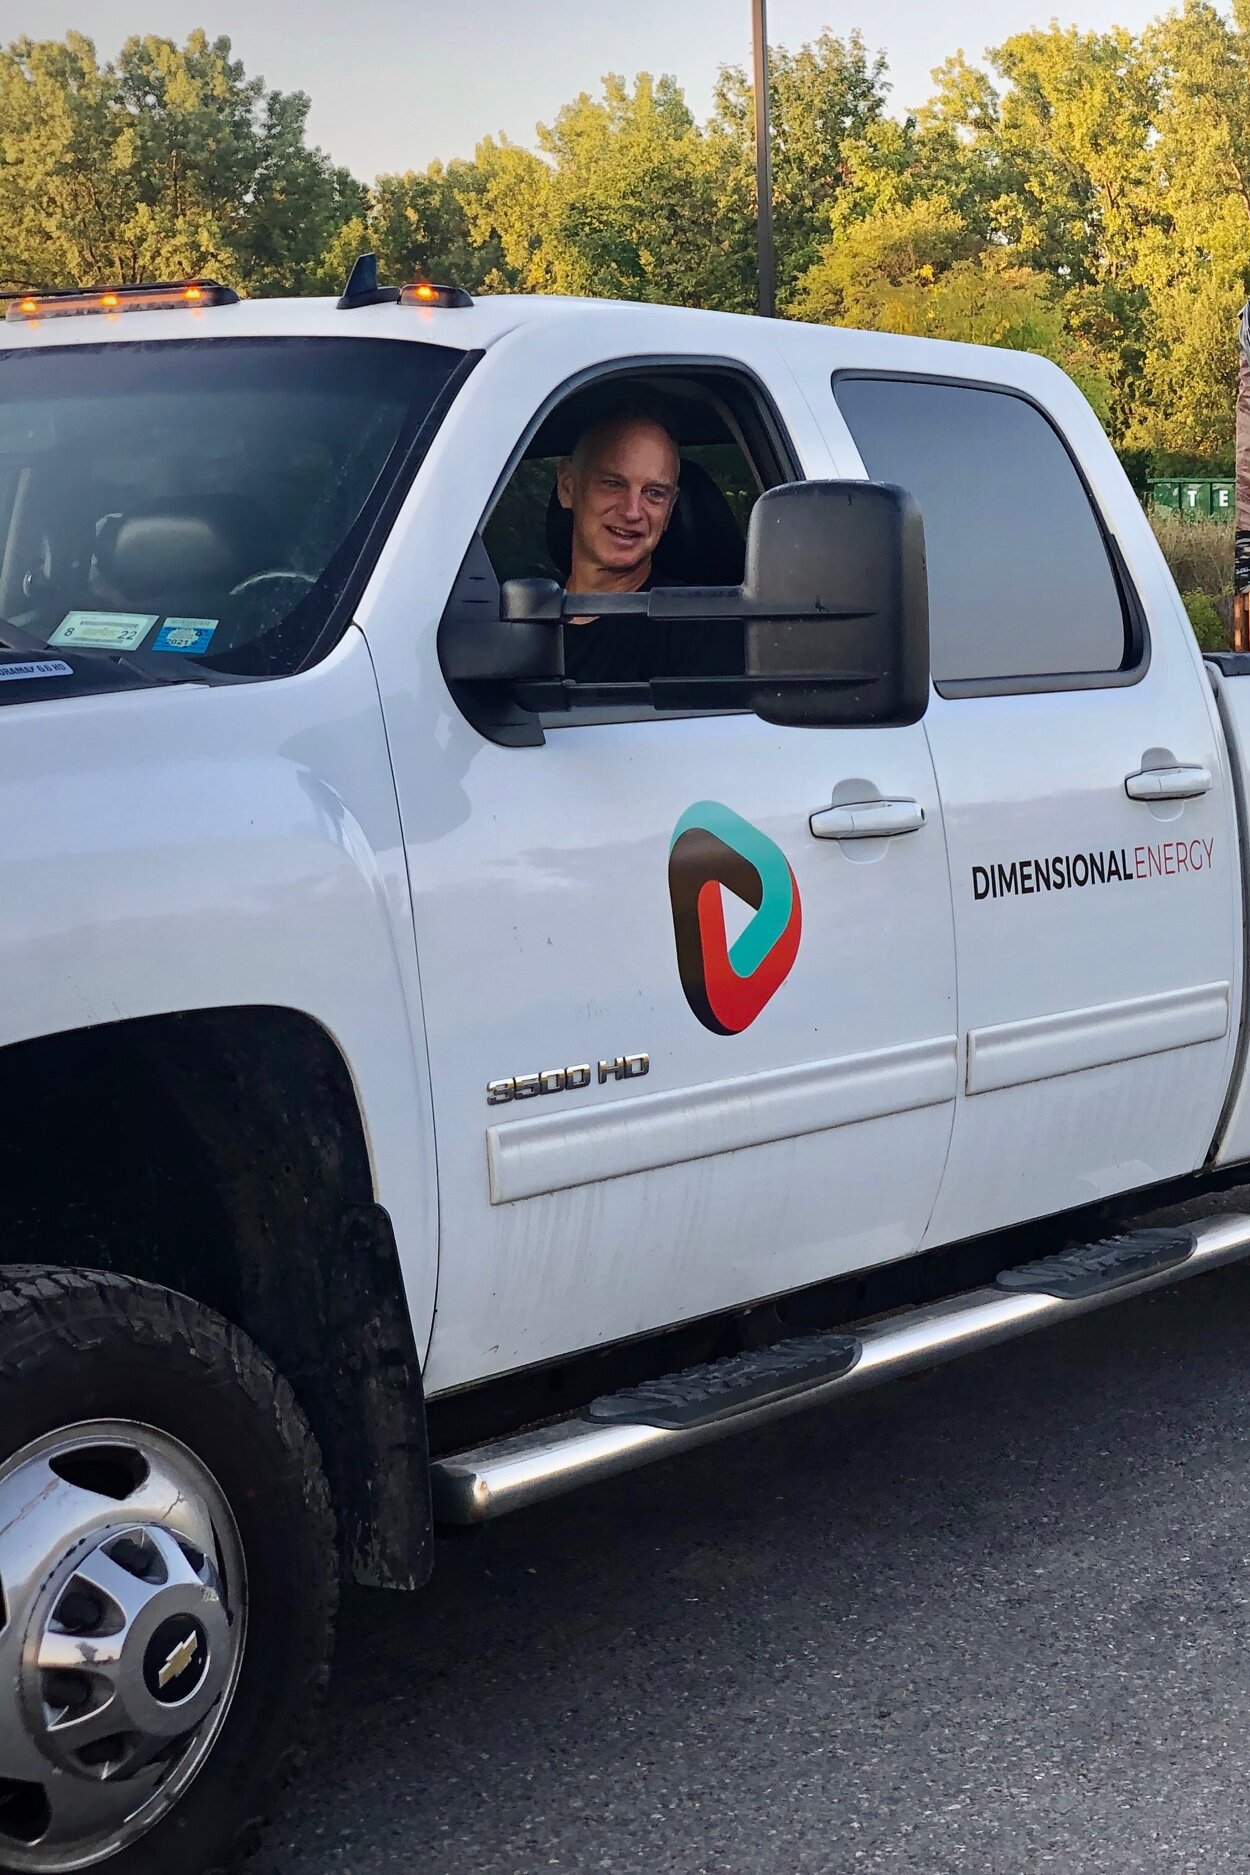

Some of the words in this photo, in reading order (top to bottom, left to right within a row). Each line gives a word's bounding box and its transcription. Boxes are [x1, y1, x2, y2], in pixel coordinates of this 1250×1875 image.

[64, 627, 75, 637] 8
[118, 630, 137, 640] 22
[972, 848, 1133, 901] DIMENSIONAL
[1134, 837, 1214, 879] ENERGY
[487, 1063, 591, 1105] 3500
[597, 1052, 650, 1085] HD
